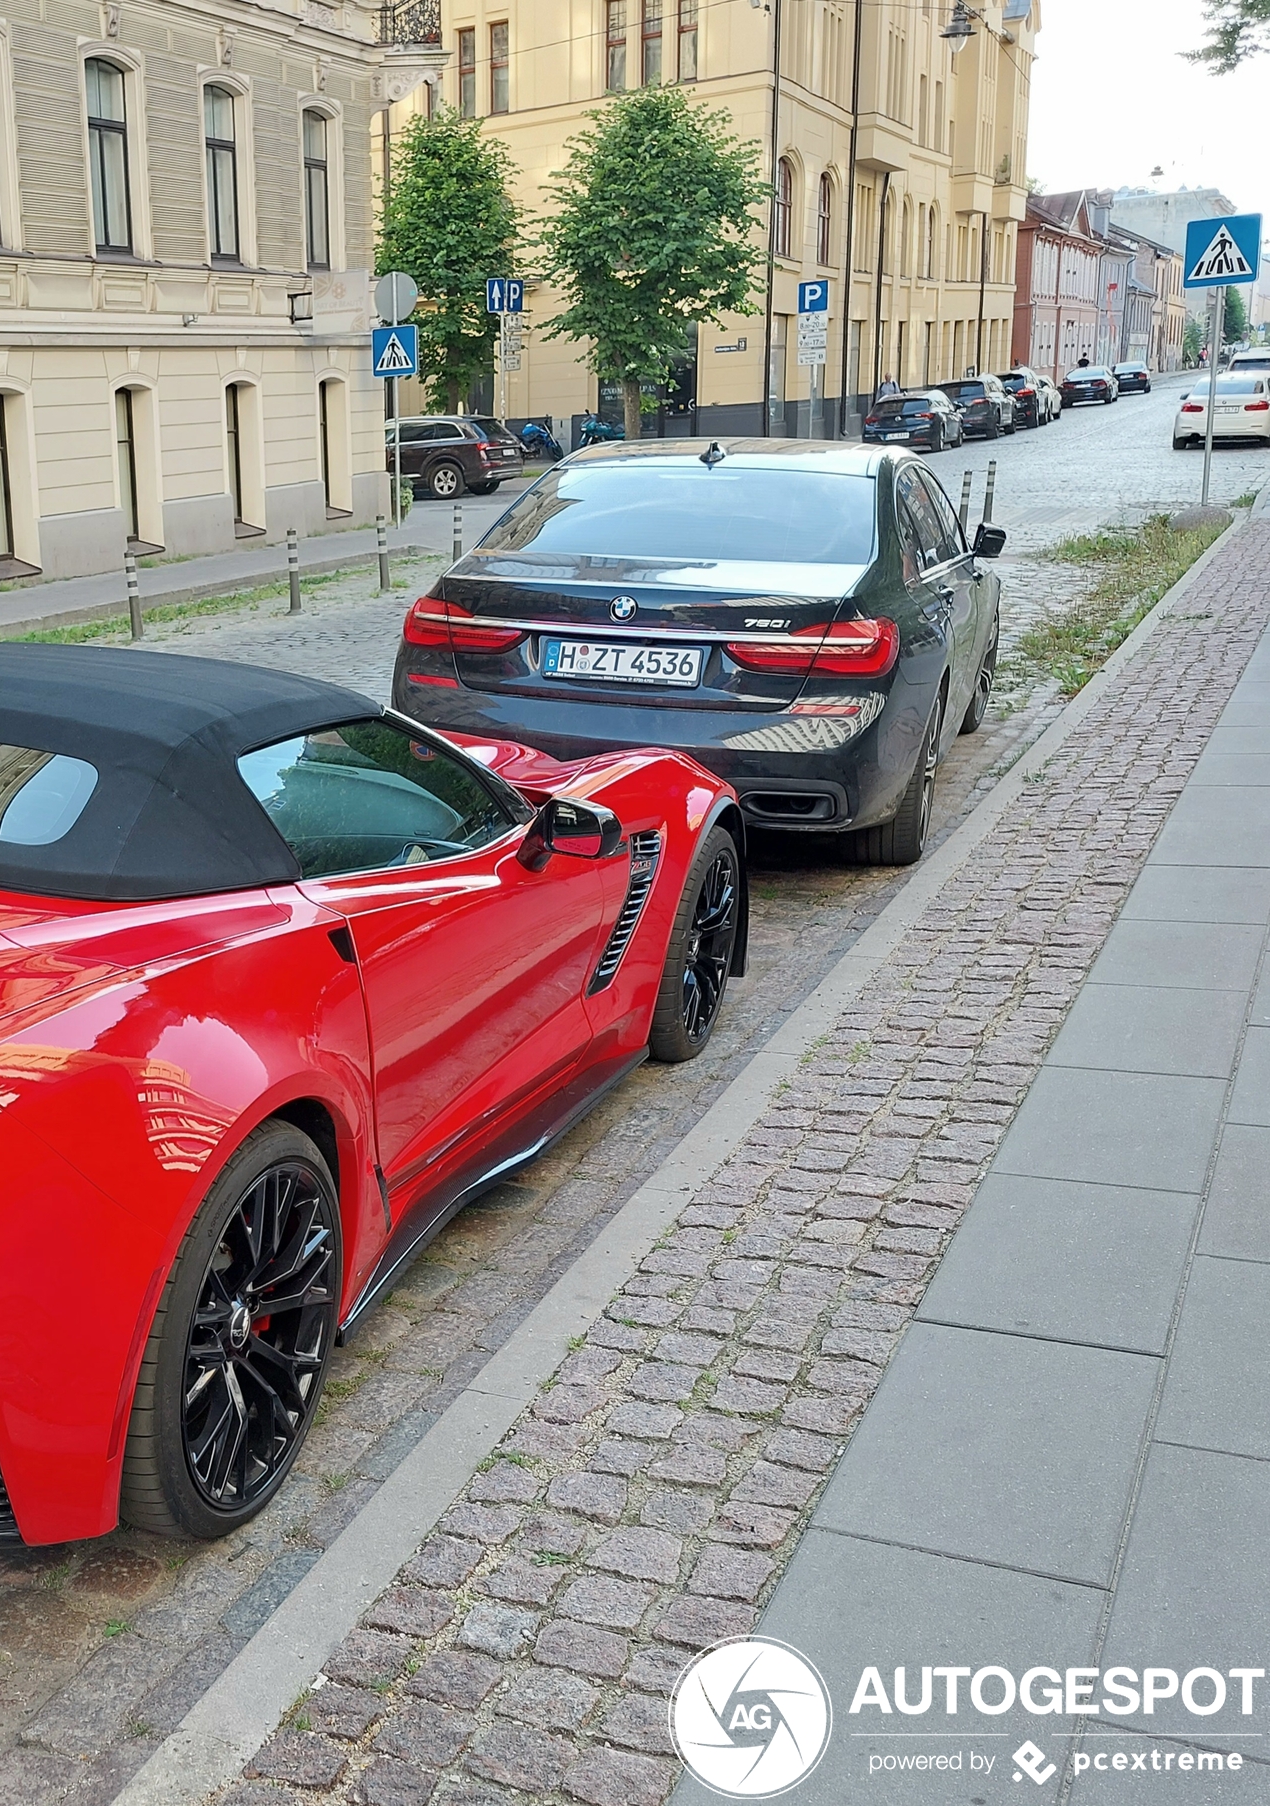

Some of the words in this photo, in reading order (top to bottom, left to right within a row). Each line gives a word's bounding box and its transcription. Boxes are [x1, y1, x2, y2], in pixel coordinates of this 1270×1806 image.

[804, 284, 822, 310] P
[744, 618, 792, 628] 750i
[549, 659, 555, 667] D
[559, 645, 577, 670] H
[591, 648, 627, 672] ZT
[629, 650, 695, 676] 4536
